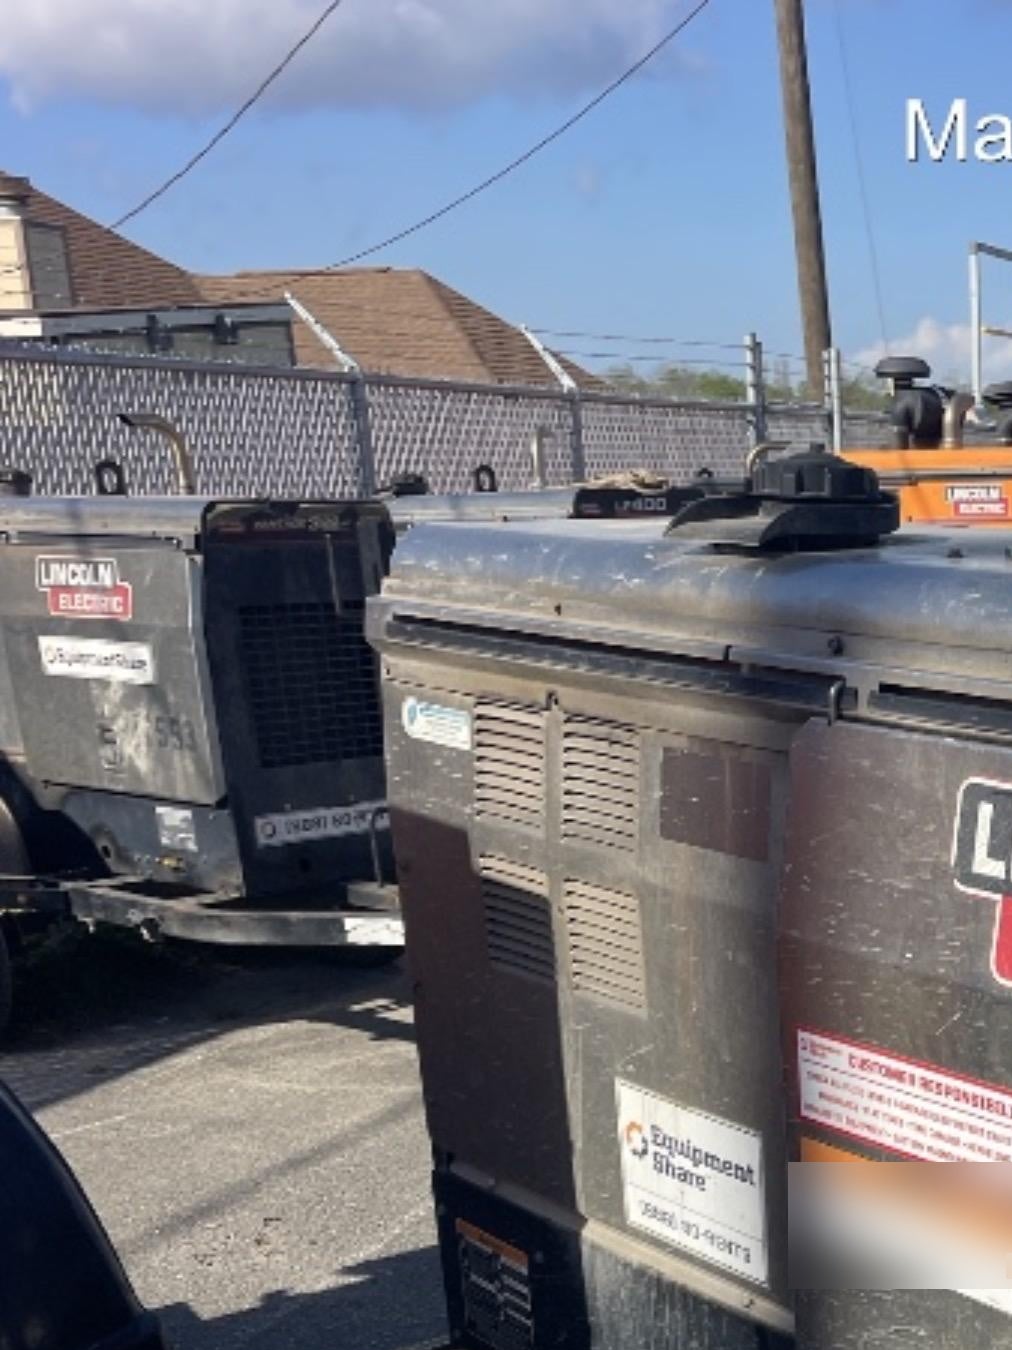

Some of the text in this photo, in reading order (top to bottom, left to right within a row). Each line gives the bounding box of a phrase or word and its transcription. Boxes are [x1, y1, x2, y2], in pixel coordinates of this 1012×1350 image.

[41, 562, 114, 587] LINCOLN
[58, 593, 124, 613] ELECTRIC
[650, 1123, 757, 1188] Equipment
[653, 1150, 707, 1192] Share
